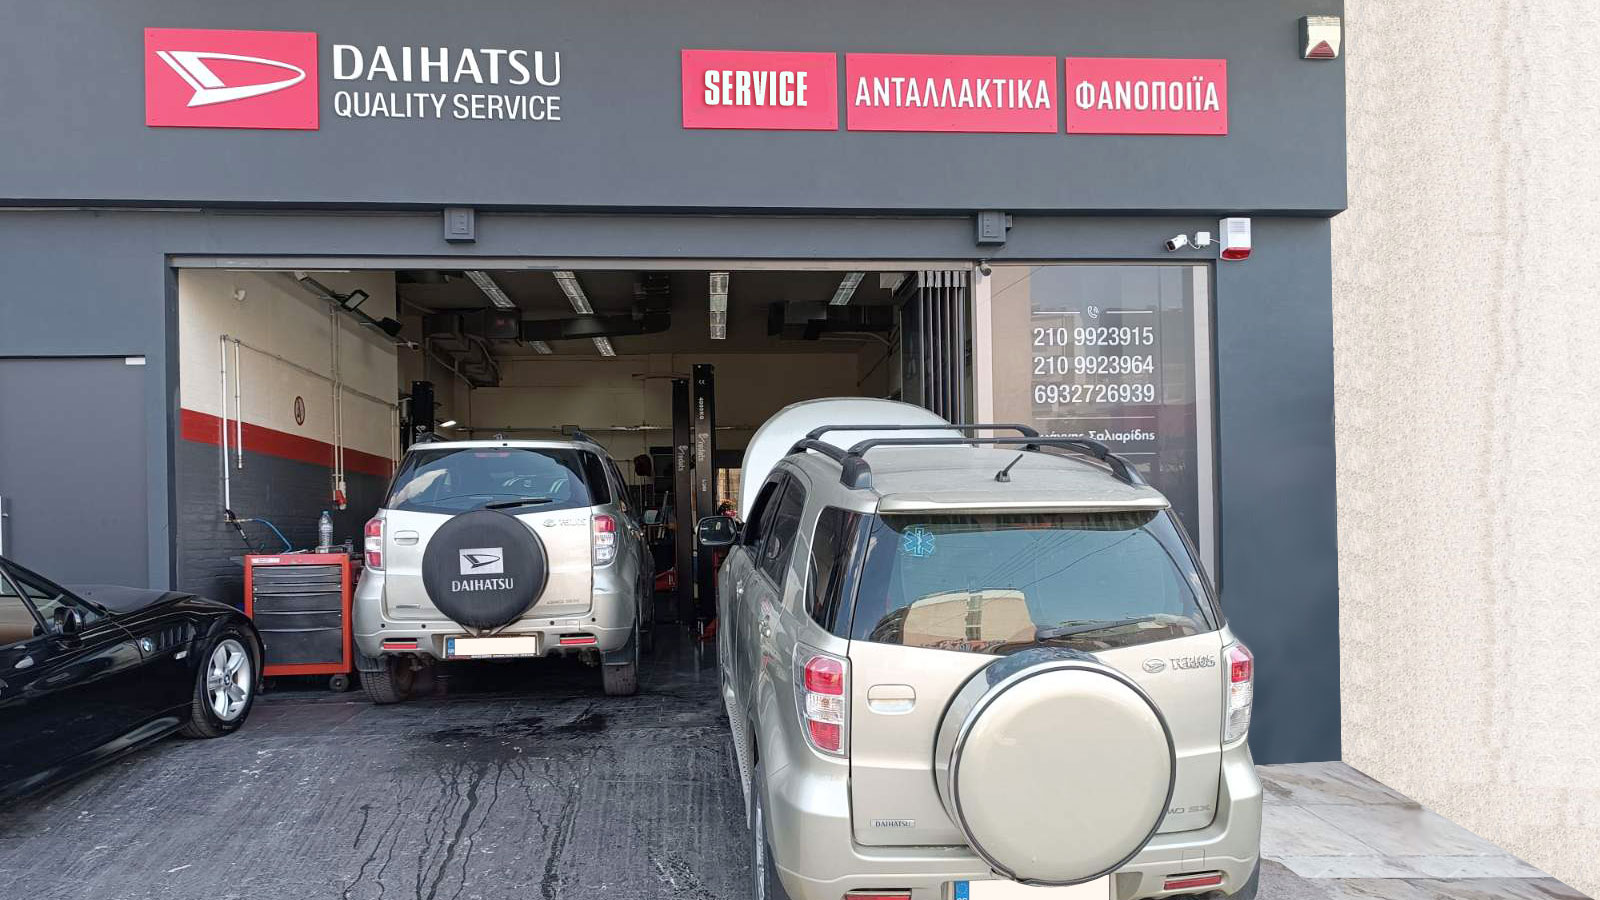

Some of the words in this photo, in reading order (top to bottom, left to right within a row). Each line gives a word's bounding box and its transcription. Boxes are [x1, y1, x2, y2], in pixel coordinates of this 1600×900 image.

[333, 44, 561, 86] DAIHATSU
[704, 69, 808, 107] SERVICE
[855, 76, 1051, 110] ΑΝΤΑΛΛΑΚΤΙΚΑ
[334, 90, 448, 118] QUALITY
[453, 94, 561, 121] SERVICE
[1033, 327, 1068, 346] 210
[1073, 326, 1154, 346] 9923915
[1033, 356, 1069, 375] 210
[1074, 355, 1155, 375] 9923964
[1034, 383, 1155, 404] 6932726939
[1088, 429, 1155, 443] Σαλιαρίδης
[451, 577, 514, 592] DAIHATSU
[875, 820, 911, 828] DAIHATSU
